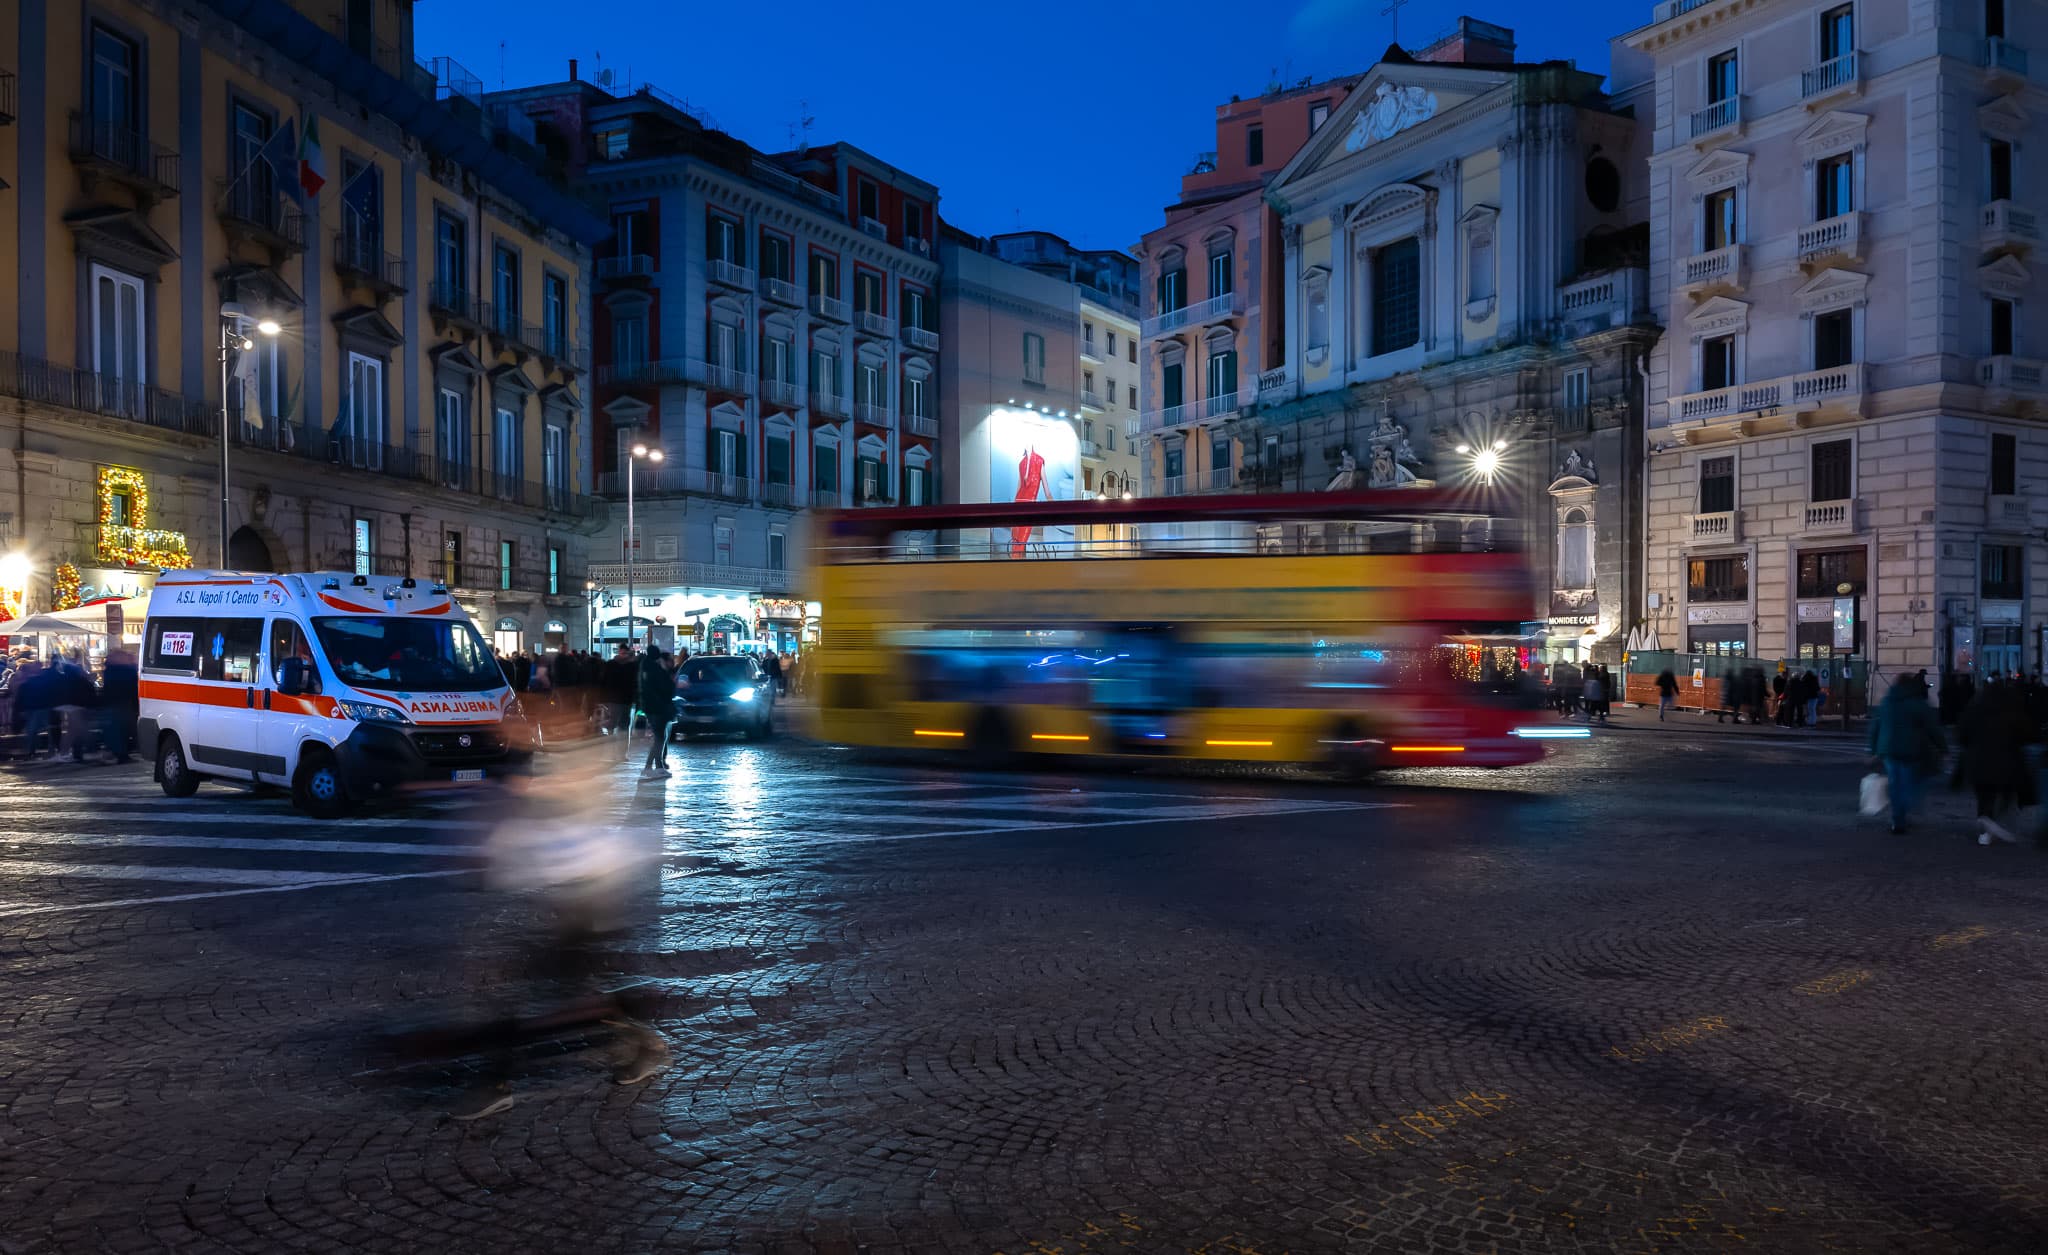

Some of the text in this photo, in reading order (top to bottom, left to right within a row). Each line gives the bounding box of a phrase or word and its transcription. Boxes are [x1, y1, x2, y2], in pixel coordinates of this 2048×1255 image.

[199, 590, 223, 606] Napoli
[225, 591, 230, 604] 1
[231, 591, 259, 604] Centro
[1548, 616, 1578, 625] MONIDEE
[173, 640, 185, 654] 118
